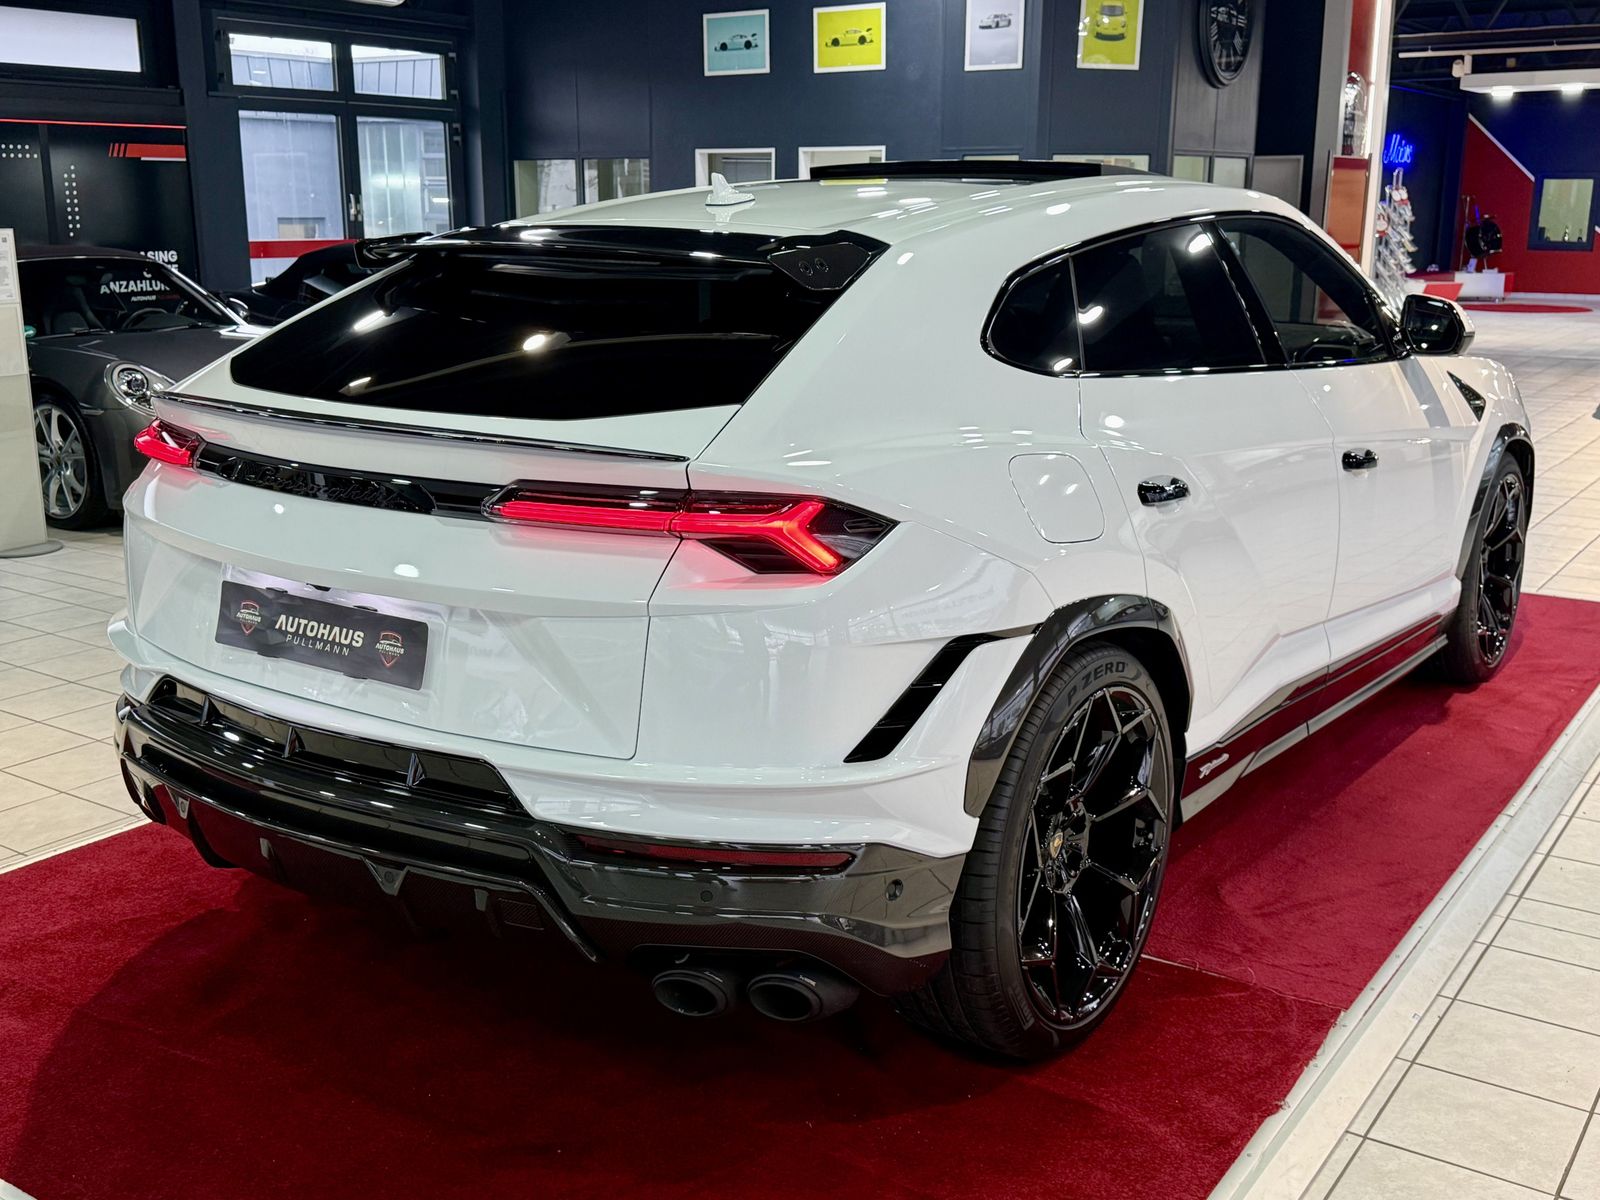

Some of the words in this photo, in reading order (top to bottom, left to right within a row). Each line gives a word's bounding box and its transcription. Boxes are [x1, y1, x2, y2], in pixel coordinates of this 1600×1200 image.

[275, 614, 364, 648] AUTOHAUS
[286, 634, 350, 656] PULLMANN
[375, 642, 404, 655] AUTOHAUS
[1067, 685, 1077, 707] P
[1082, 661, 1126, 690] ZERO
